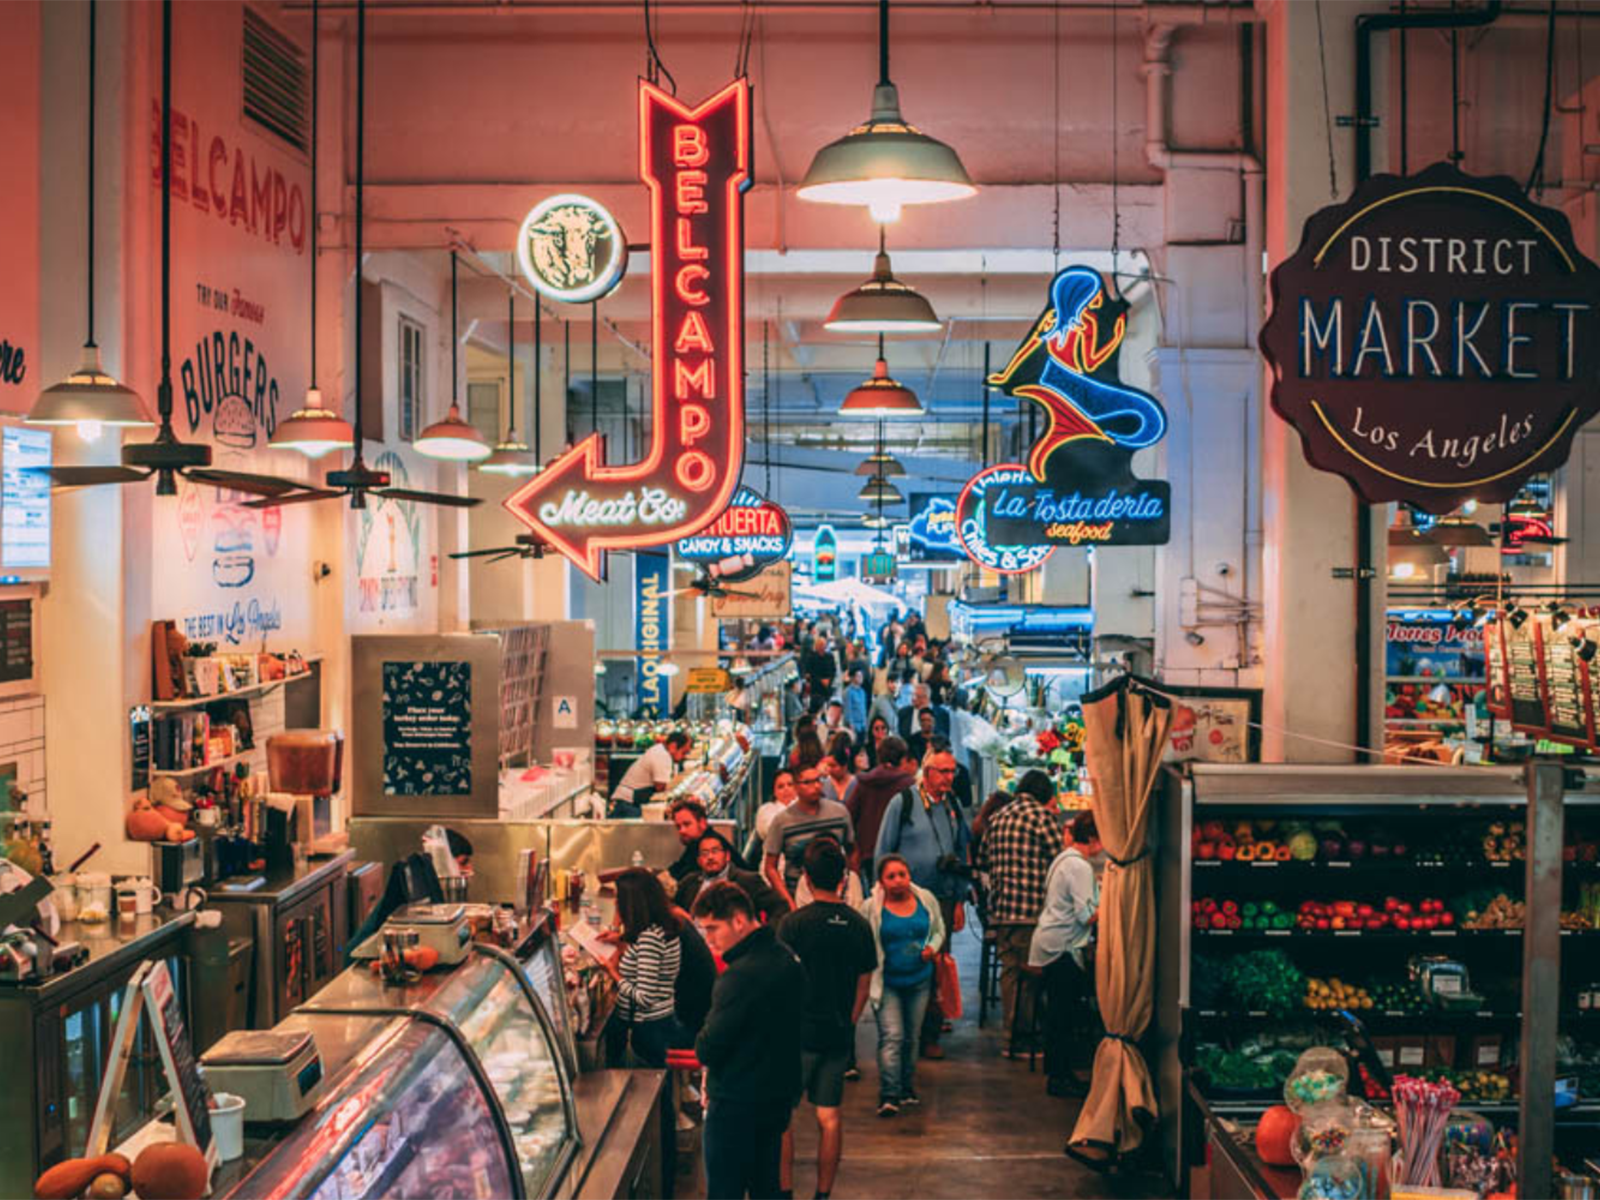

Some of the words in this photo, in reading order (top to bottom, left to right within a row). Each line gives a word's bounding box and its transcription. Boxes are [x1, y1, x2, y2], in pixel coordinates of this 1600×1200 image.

[1350, 236, 1538, 275] DISTRICT
[674, 124, 716, 492] BELCAMPO
[1302, 299, 1590, 380] MARKET
[181, 331, 279, 439] BURGERS
[1352, 407, 1399, 450] Los
[1409, 414, 1534, 468] Angeles
[541, 489, 636, 525] Meat
[992, 487, 1027, 518] La
[678, 537, 721, 554] CANDY
[733, 535, 785, 555] SNACKS
[1045, 520, 1114, 544] seafood
[557, 698, 572, 714] A
